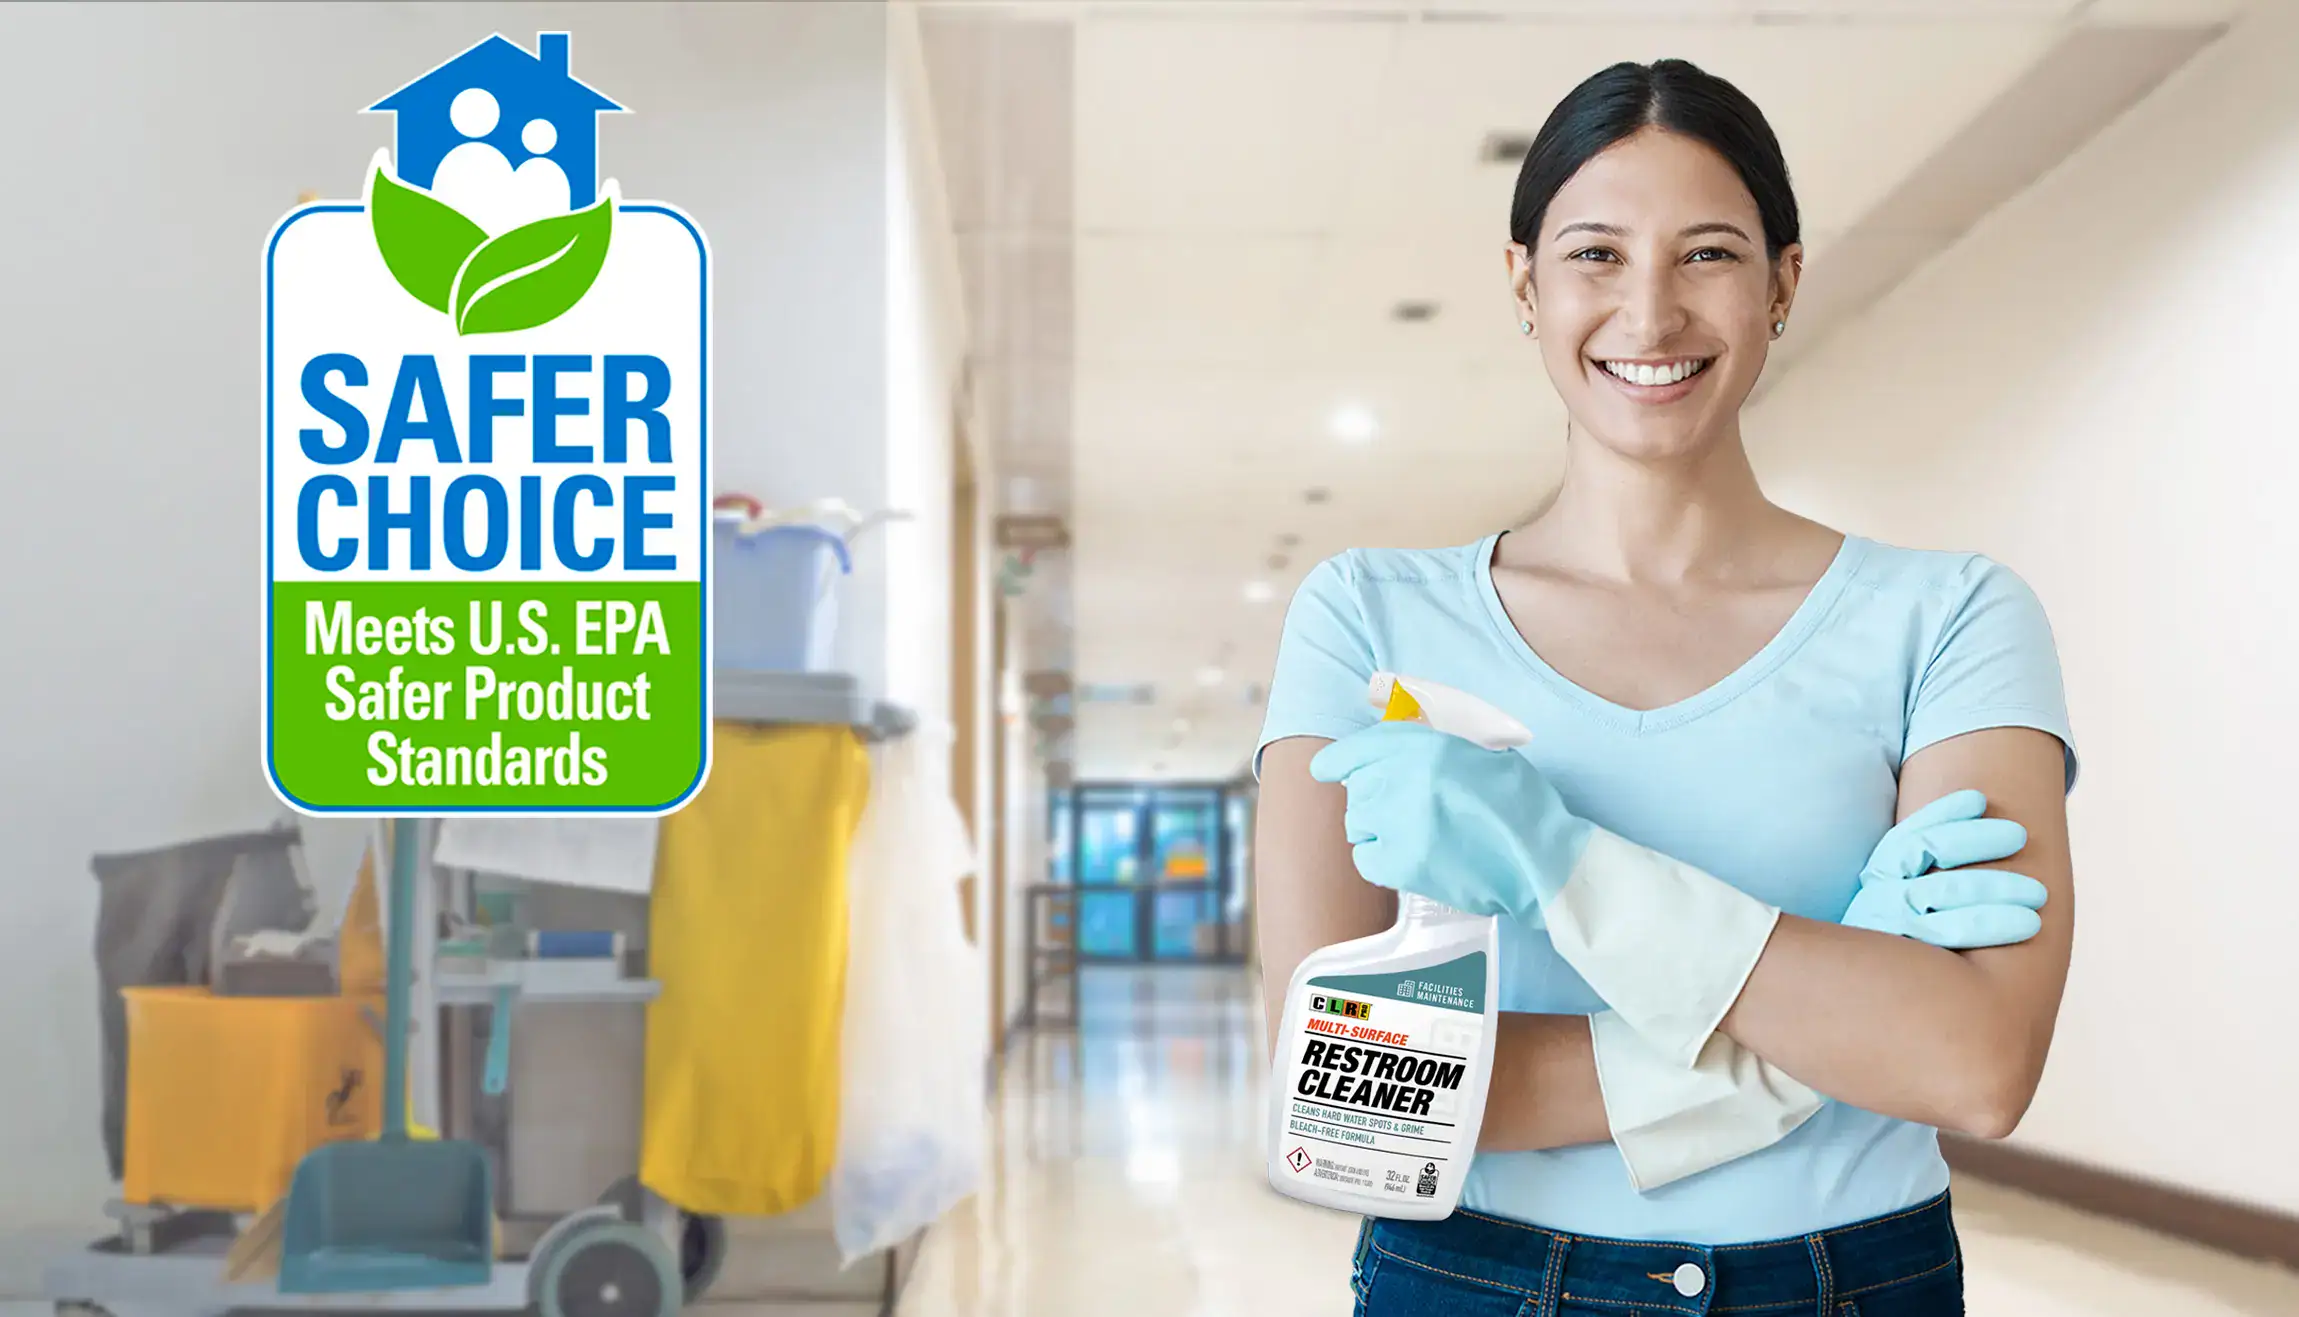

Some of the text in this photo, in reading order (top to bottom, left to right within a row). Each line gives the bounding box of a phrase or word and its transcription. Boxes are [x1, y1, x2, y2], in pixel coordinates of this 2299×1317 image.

[1417, 990, 1475, 1008] MAINTENANCE
[1418, 982, 1464, 997] FACILITIES
[1312, 997, 1357, 1017] CLR
[1307, 1018, 1410, 1046] MULTI-SURFACE
[1301, 1039, 1466, 1090] RESTROOM
[1297, 1069, 1435, 1116] CLEANER
[1290, 1119, 1376, 1146] BLEACH-FREE FORMULA
[1292, 1104, 1425, 1136] CLEANS HARD WATER SPOTS & GRIME
[1385, 1169, 1396, 1181] 32
